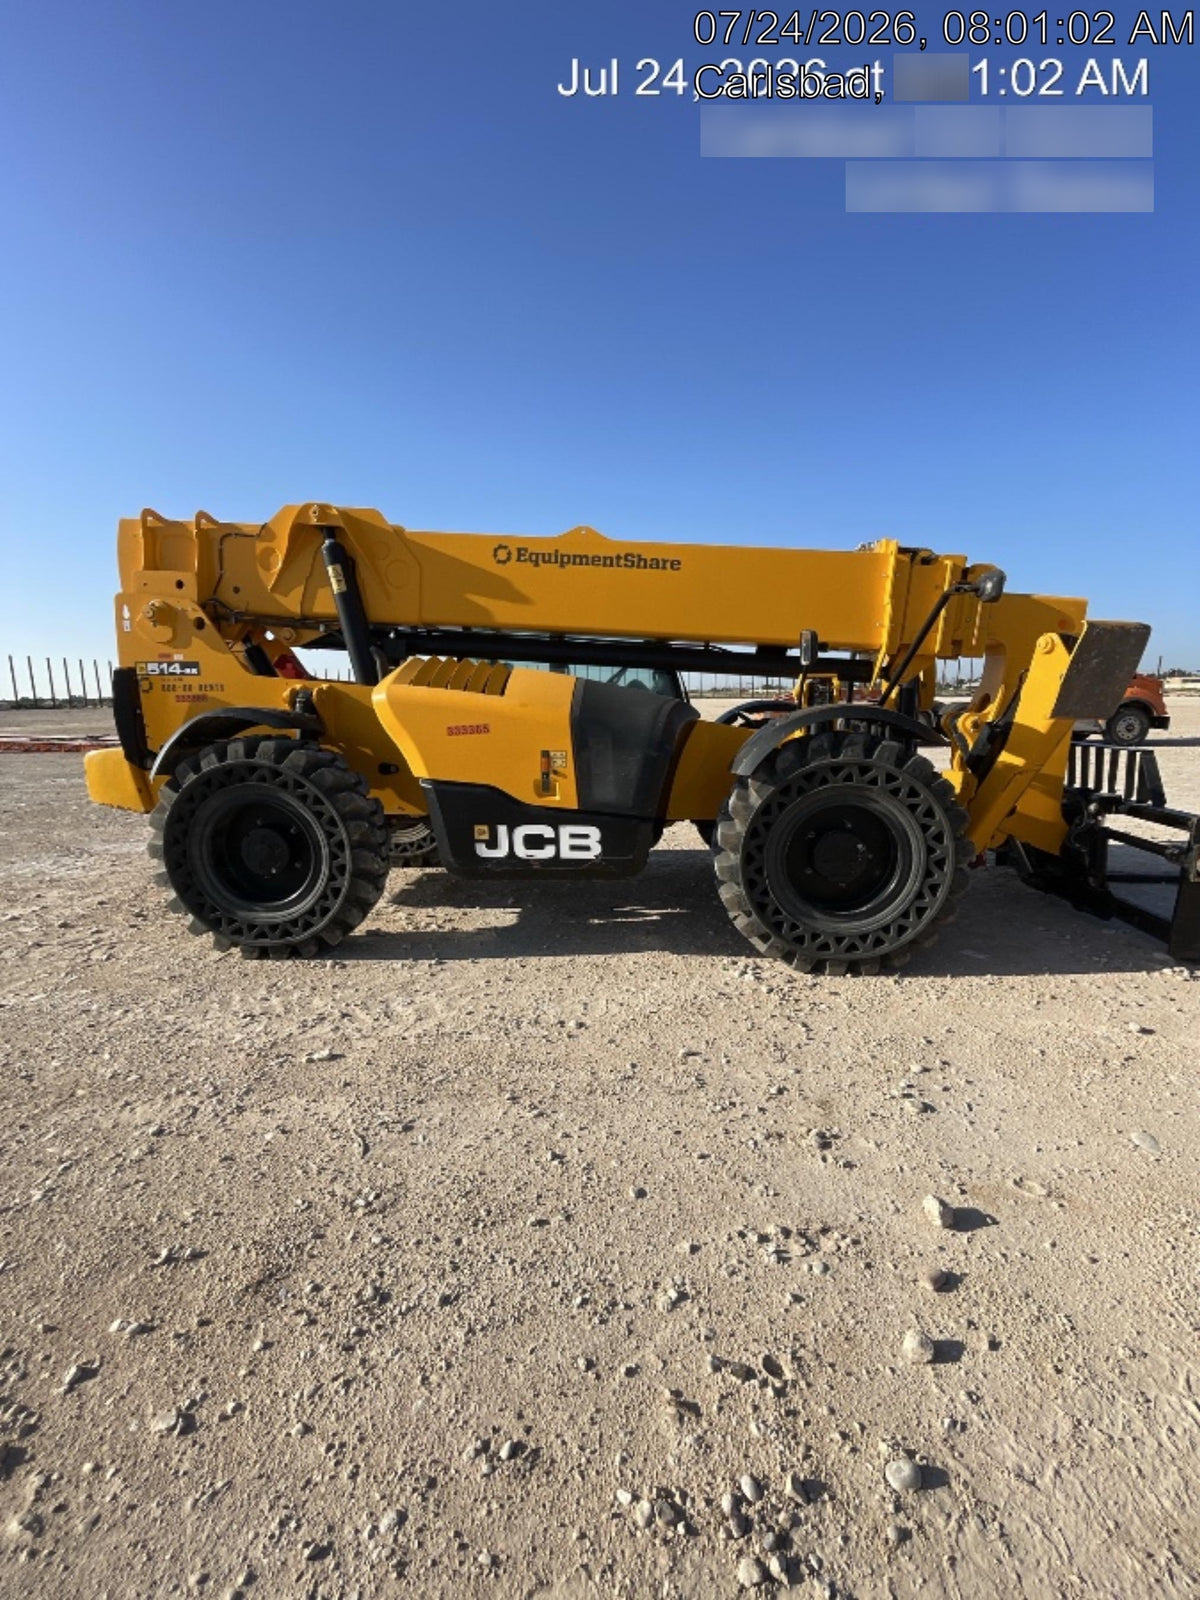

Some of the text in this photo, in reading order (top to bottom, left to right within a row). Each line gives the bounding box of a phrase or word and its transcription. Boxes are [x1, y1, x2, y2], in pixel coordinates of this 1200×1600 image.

[516, 547, 682, 571] EquipmentShare
[146, 662, 198, 675] 514-
[474, 824, 602, 860] JCB
